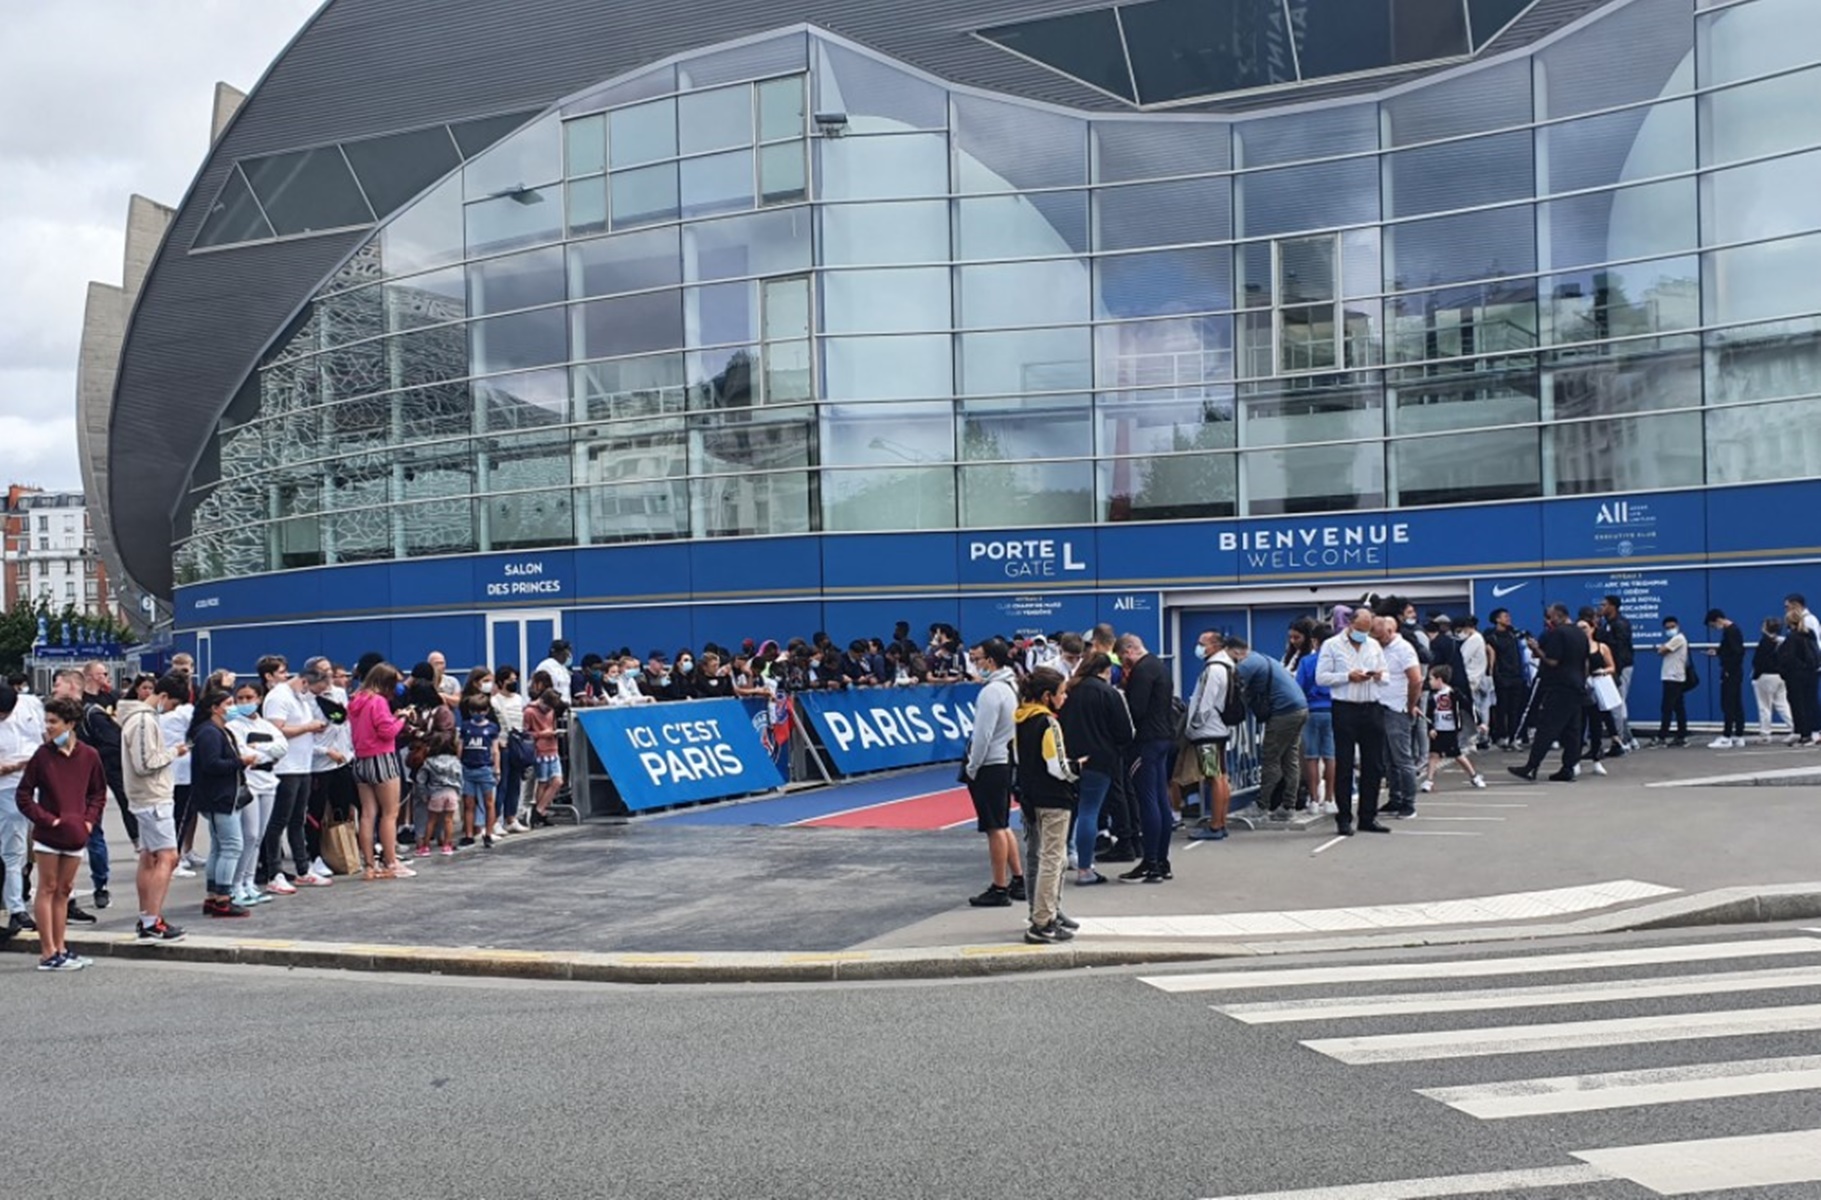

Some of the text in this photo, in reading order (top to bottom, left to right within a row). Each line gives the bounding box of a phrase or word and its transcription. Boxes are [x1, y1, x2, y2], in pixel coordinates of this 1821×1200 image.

[1219, 523, 1409, 551] BIENVENUE
[504, 562, 542, 576] SALON
[970, 540, 1086, 570] PORTE L
[1004, 560, 1055, 577] GATE
[1247, 547, 1381, 568] WELCOME
[487, 580, 561, 595] DES PRINCES
[625, 719, 722, 750] ICI C'EST
[823, 704, 935, 752] PARIS
[639, 744, 744, 787] PARIS
